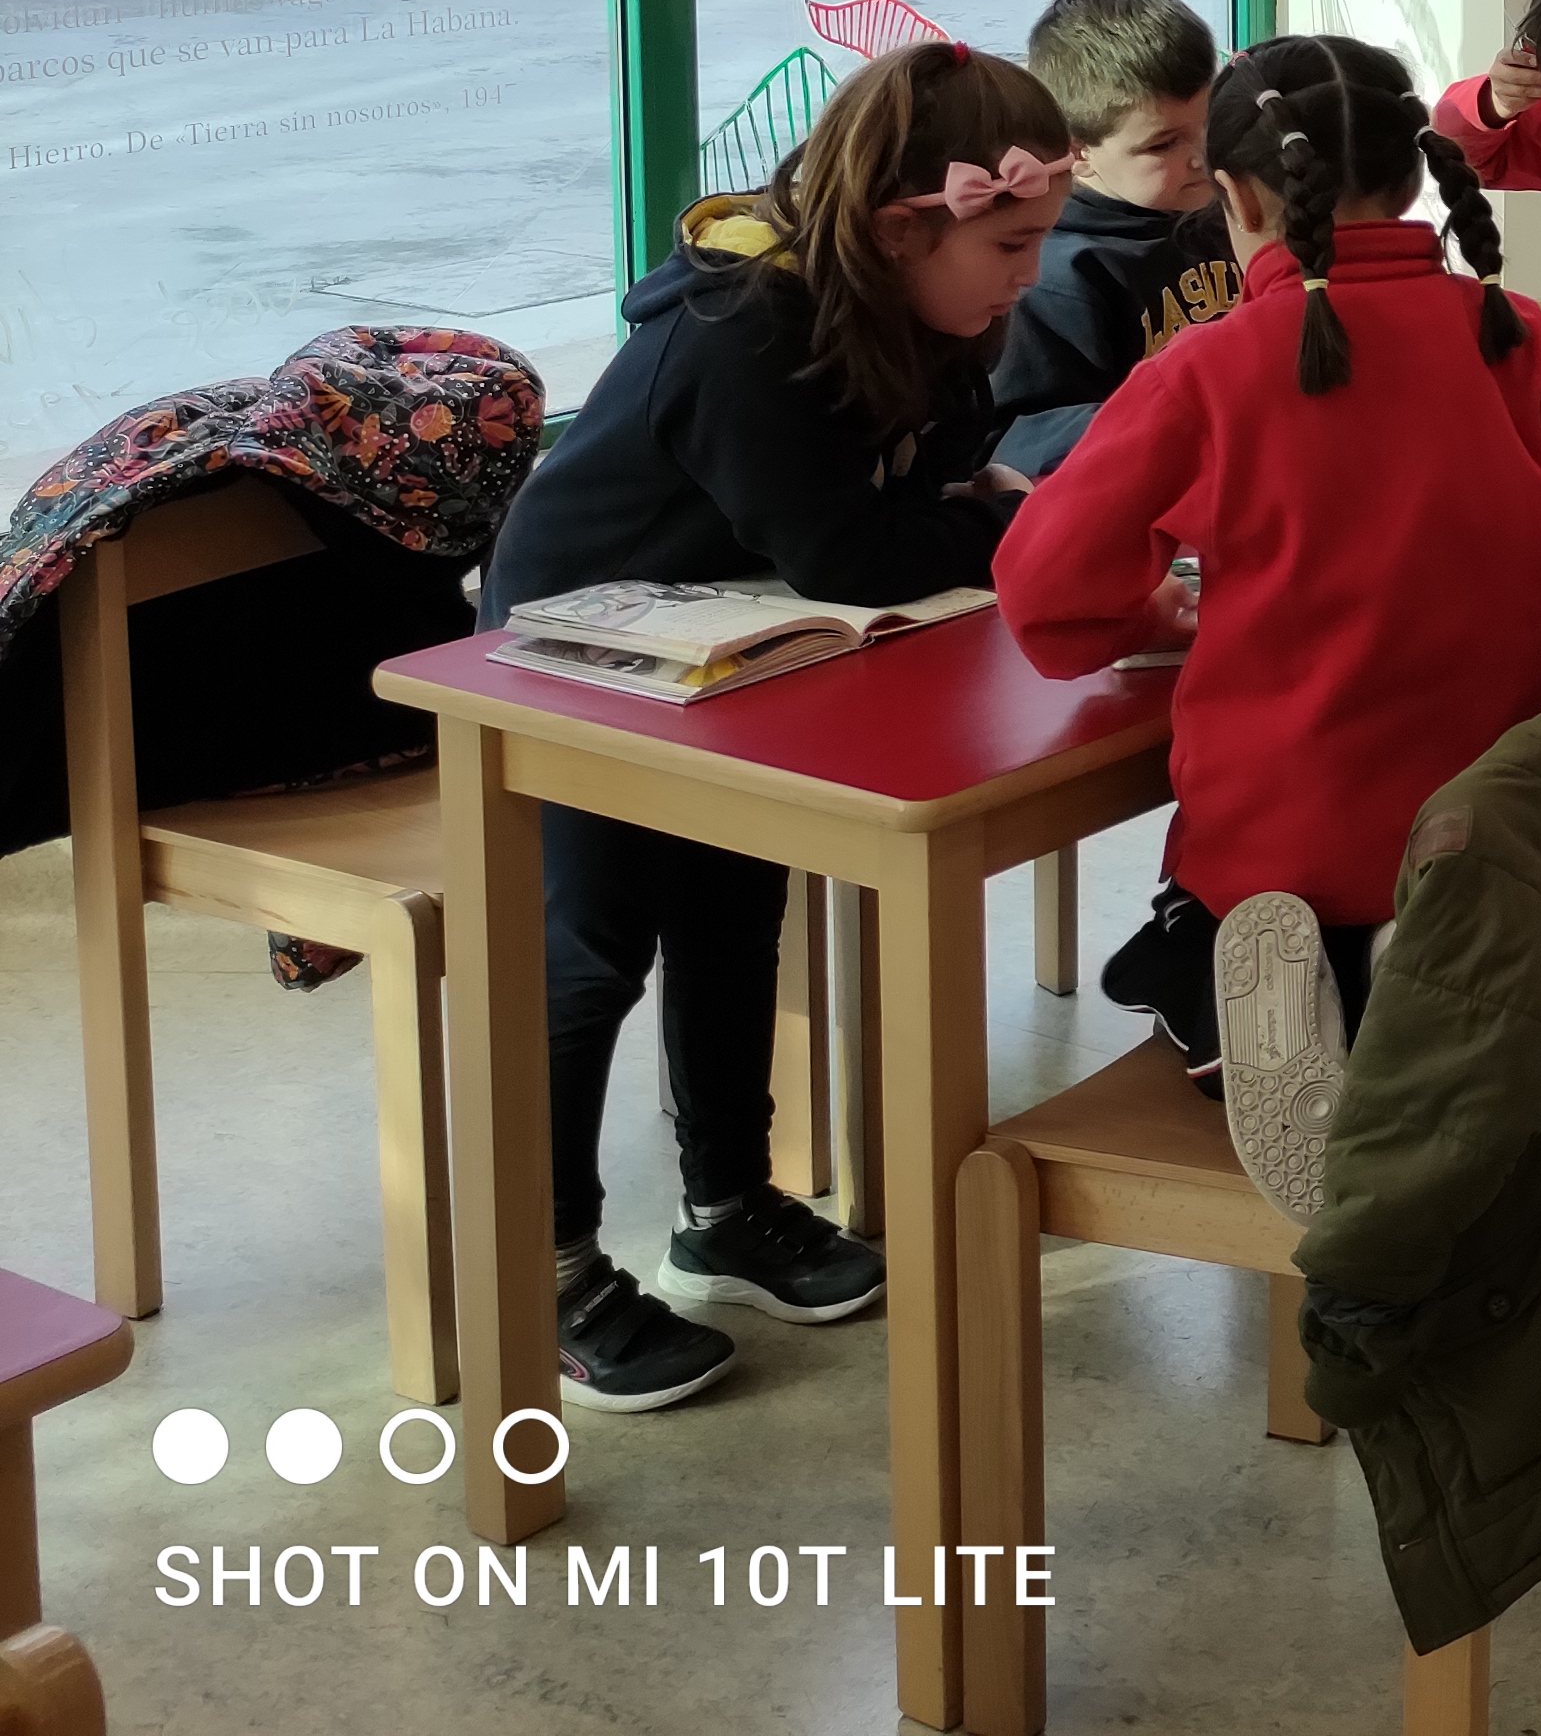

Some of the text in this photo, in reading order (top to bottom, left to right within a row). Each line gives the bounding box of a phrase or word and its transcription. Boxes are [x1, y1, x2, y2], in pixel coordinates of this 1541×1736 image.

[108, 46, 166, 77] que
[178, 40, 209, 63] se
[221, 35, 273, 58] van
[286, 26, 350, 57] para
[361, 16, 395, 42] La
[408, 7, 520, 37] Habana.
[9, 143, 113, 170] Hierro.
[127, 130, 164, 155] De
[176, 116, 269, 148] «Tierra
[280, 110, 317, 133] sin
